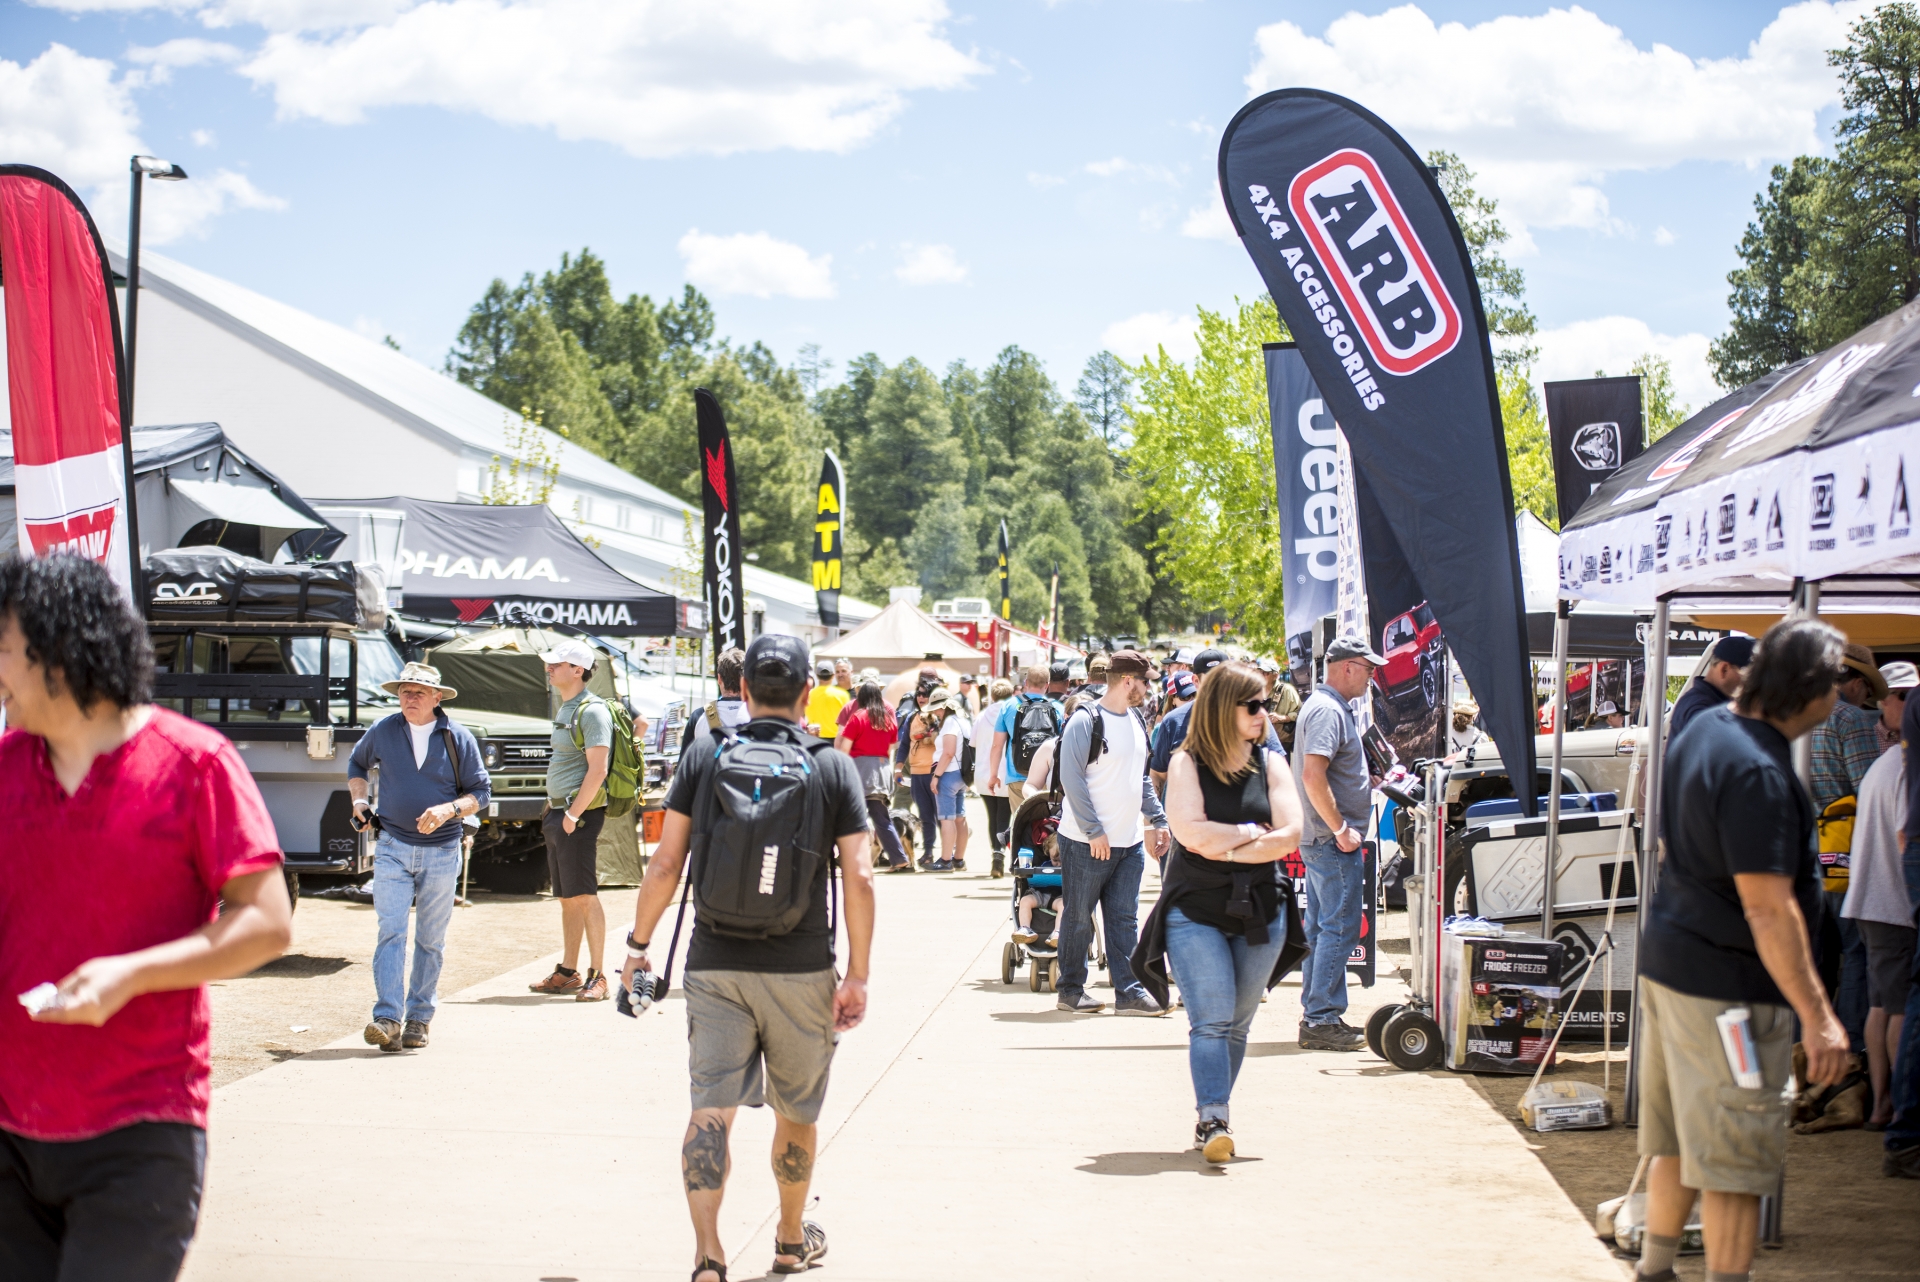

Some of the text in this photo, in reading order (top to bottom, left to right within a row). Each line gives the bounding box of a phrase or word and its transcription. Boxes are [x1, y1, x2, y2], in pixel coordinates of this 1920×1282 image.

[1310, 180, 1437, 351] ARB
[1248, 184, 1386, 411] 4X4 ACCESSORIES
[1296, 398, 1338, 581] Jeep
[812, 483, 841, 592] ATM
[156, 583, 218, 598] CVT
[714, 512, 737, 652] YOKOH
[493, 602, 632, 626] YOKOHAMA
[1667, 630, 1720, 641] RAM
[520, 749, 546, 758] TOYOTA
[759, 845, 779, 895] THULE
[1484, 961, 1548, 974] FRIDGE FREEZER
[1558, 1011, 1626, 1023] ELEMENTS
